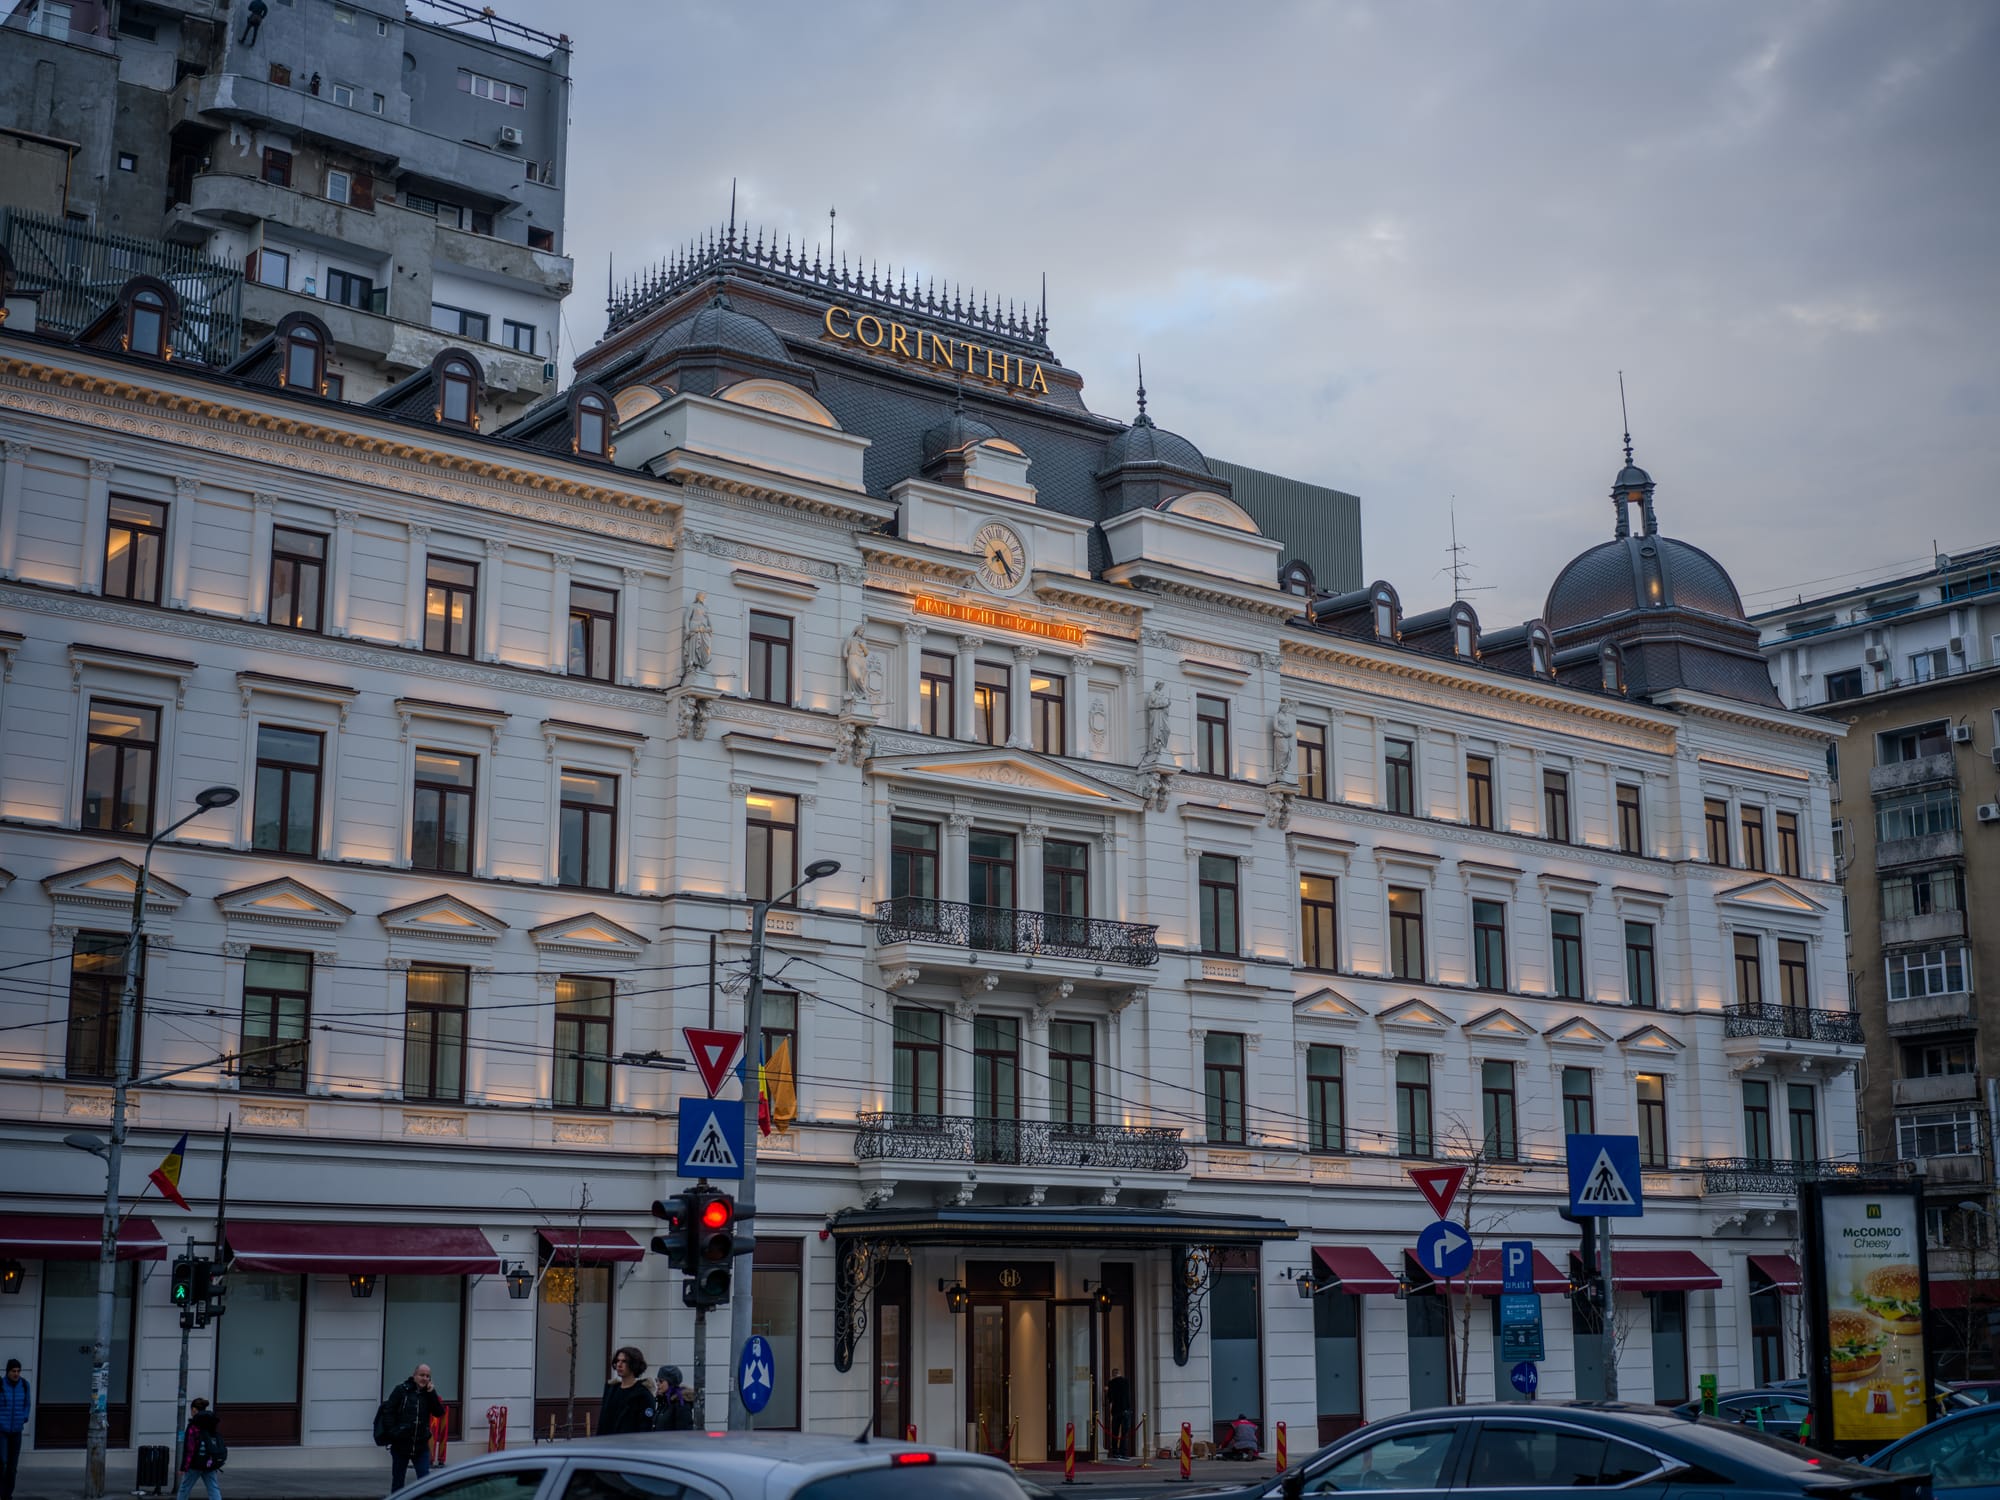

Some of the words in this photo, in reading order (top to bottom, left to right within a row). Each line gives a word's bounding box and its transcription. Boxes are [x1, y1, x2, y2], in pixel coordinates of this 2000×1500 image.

[824, 306, 1049, 393] CORINTHIA
[916, 598, 956, 617] GRAND
[1843, 1227, 1901, 1238] McCOMBO
[1854, 1238, 1892, 1250] Cheesy
[1509, 1248, 1525, 1277] P
